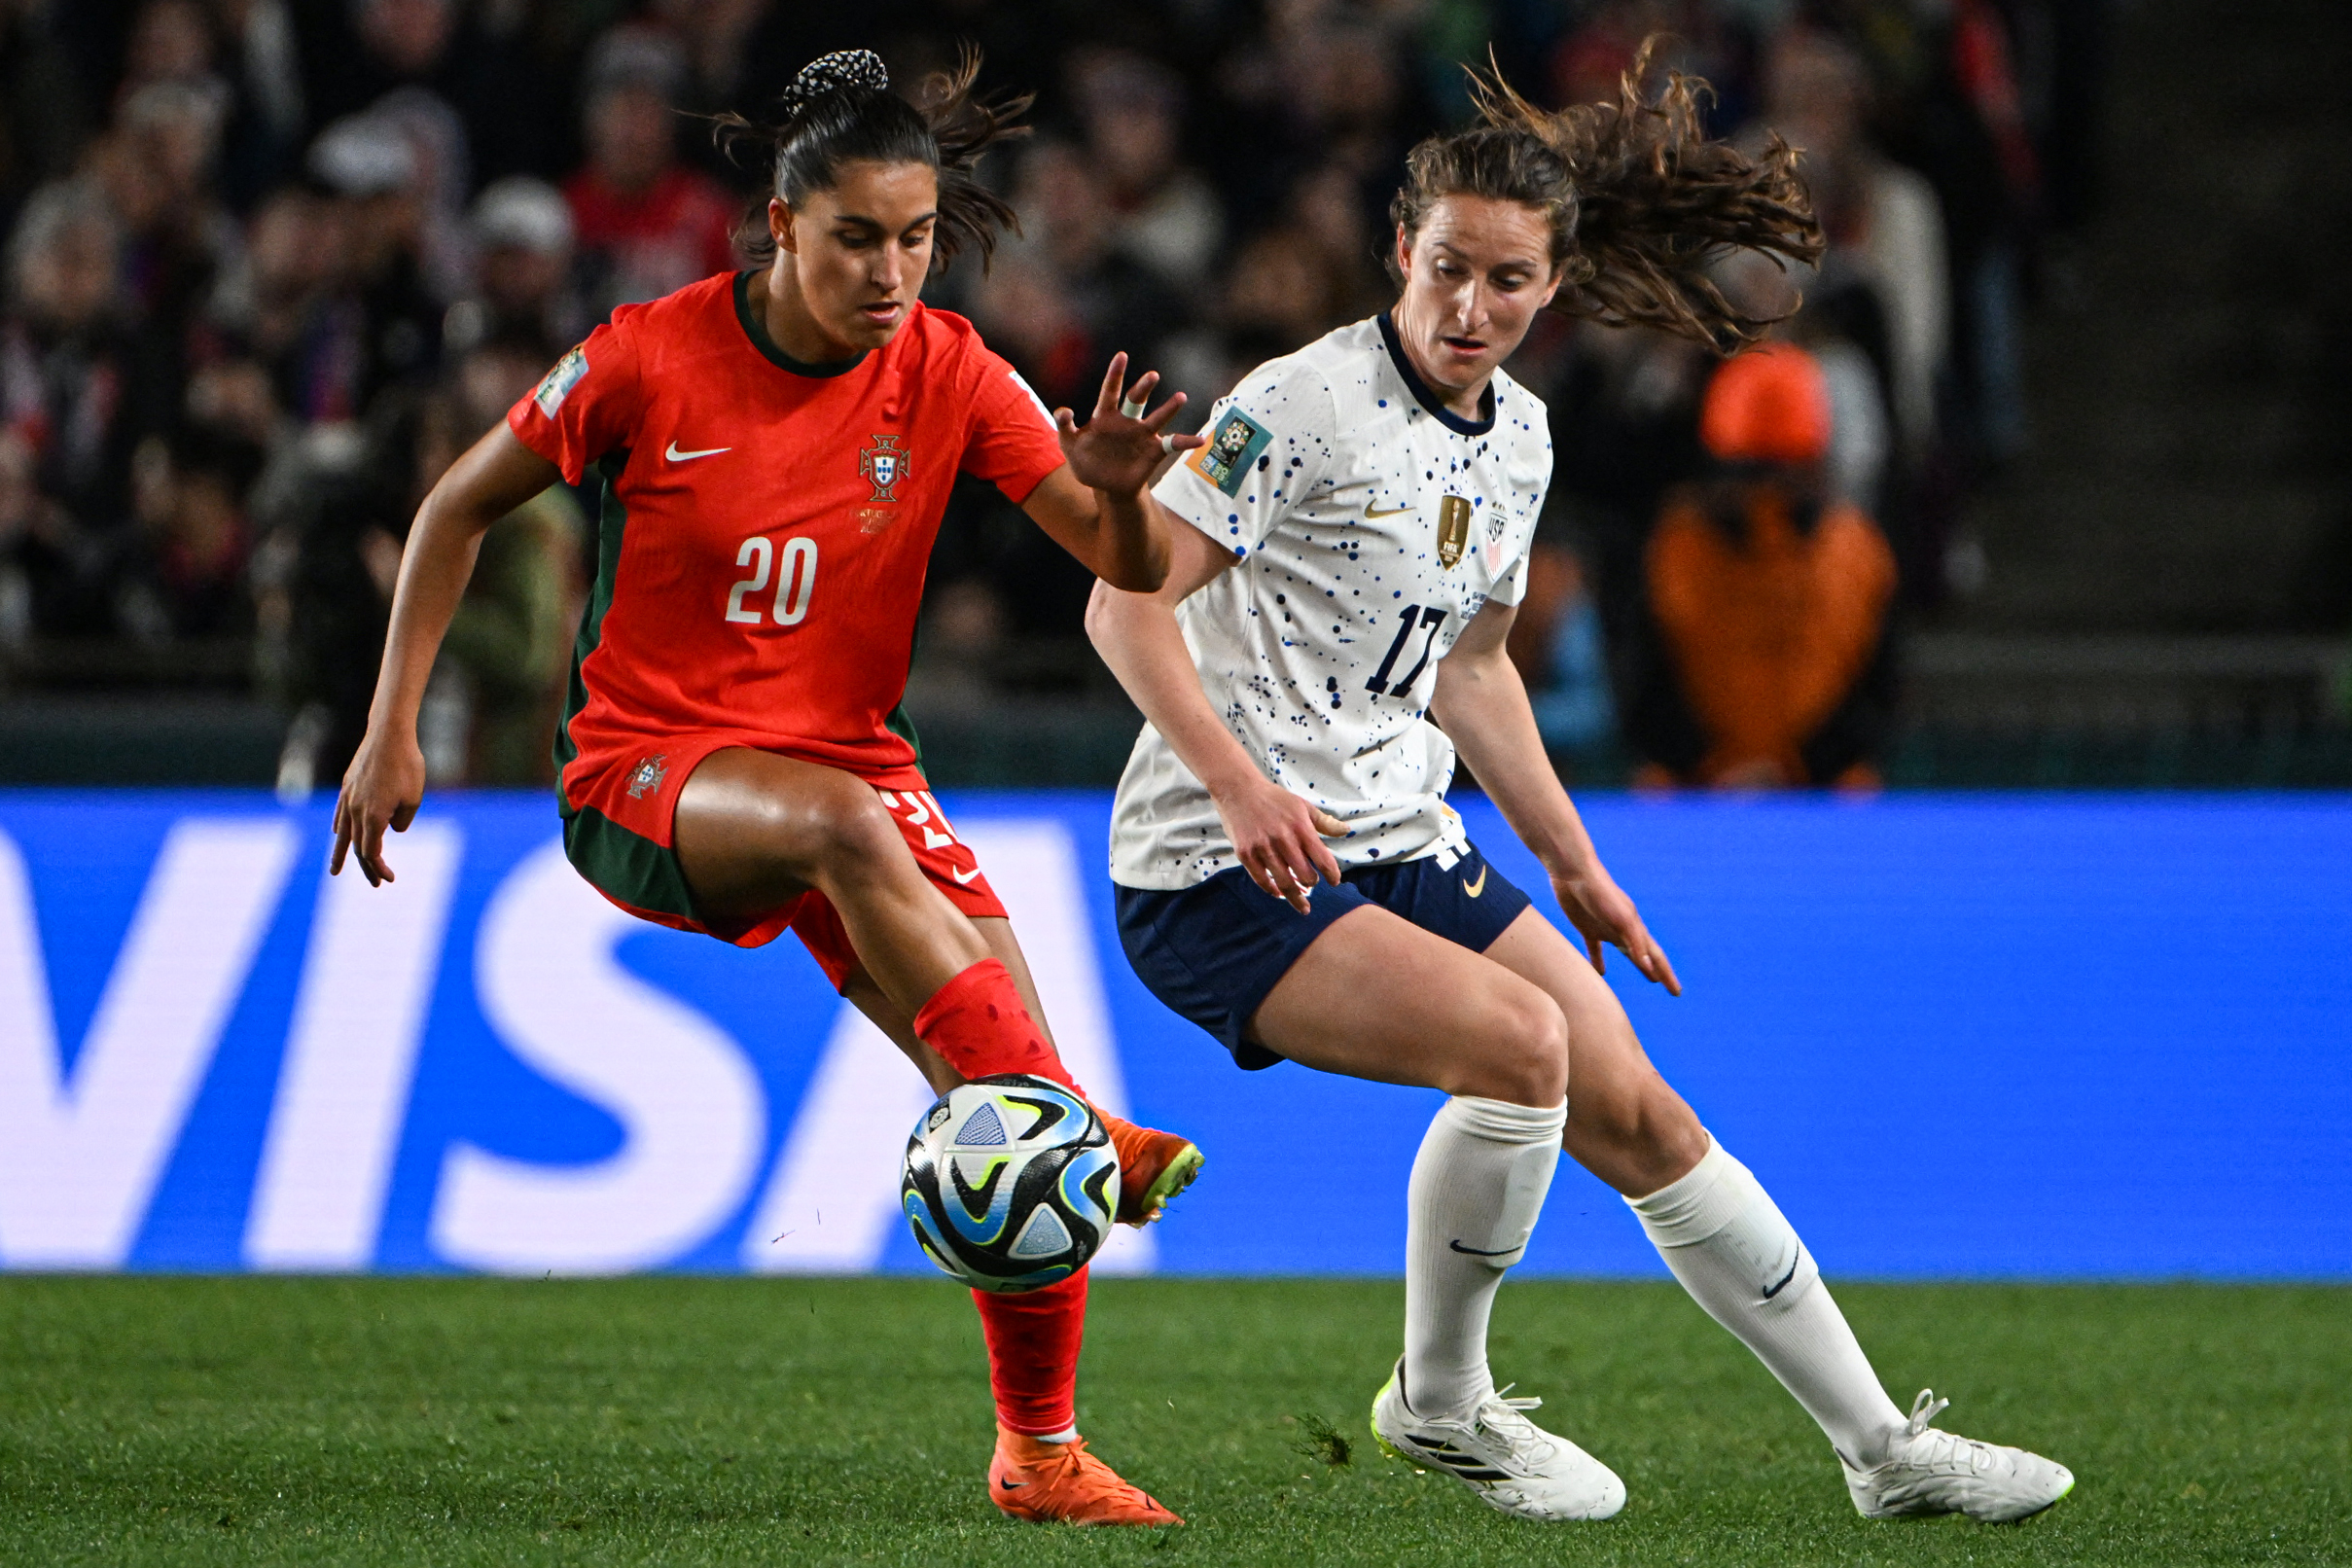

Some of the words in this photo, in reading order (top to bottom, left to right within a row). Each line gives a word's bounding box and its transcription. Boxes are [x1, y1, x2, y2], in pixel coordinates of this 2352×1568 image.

[1488, 517, 1505, 543] USA
[725, 536, 818, 625] 20
[1364, 603, 1448, 698] 17
